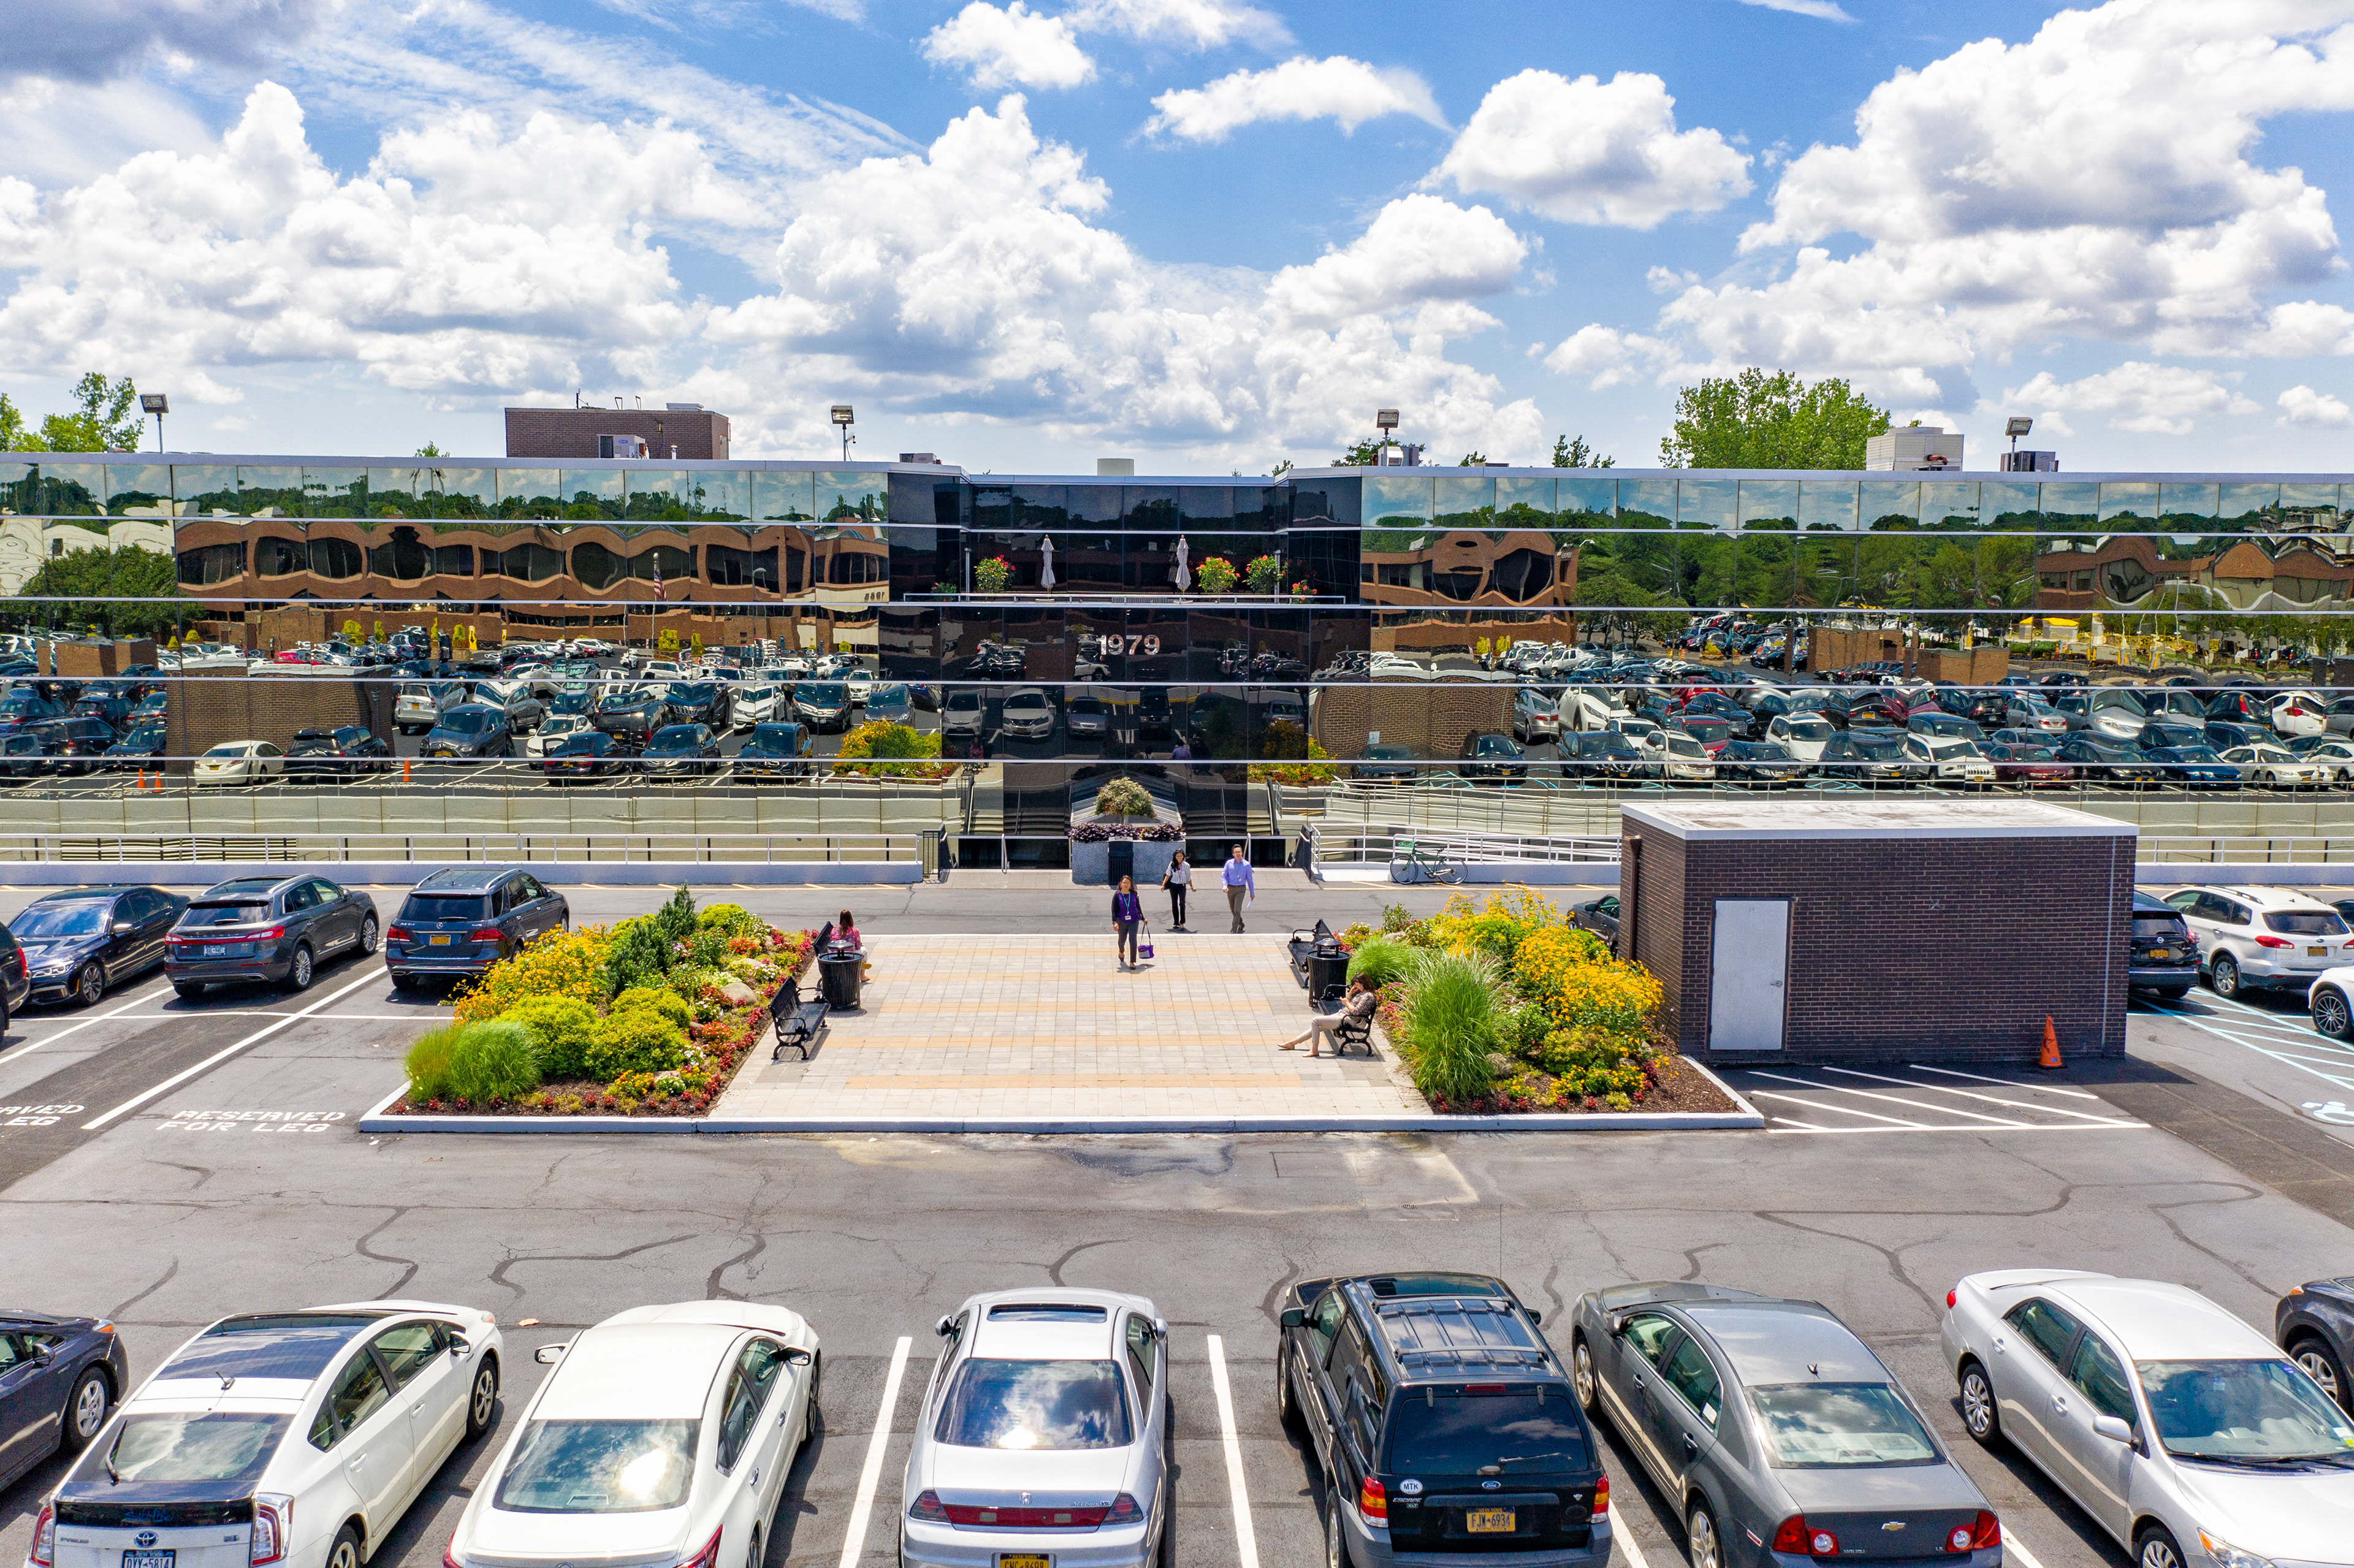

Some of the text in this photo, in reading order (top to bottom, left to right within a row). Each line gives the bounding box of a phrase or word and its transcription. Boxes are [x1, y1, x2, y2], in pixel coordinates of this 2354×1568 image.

[1096, 634, 1160, 655] 1979
[0, 1105, 85, 1114] RVED
[0, 1116, 61, 1125] EG
[172, 1110, 346, 1121] RESERVED
[155, 1121, 331, 1133] FOR LEG
